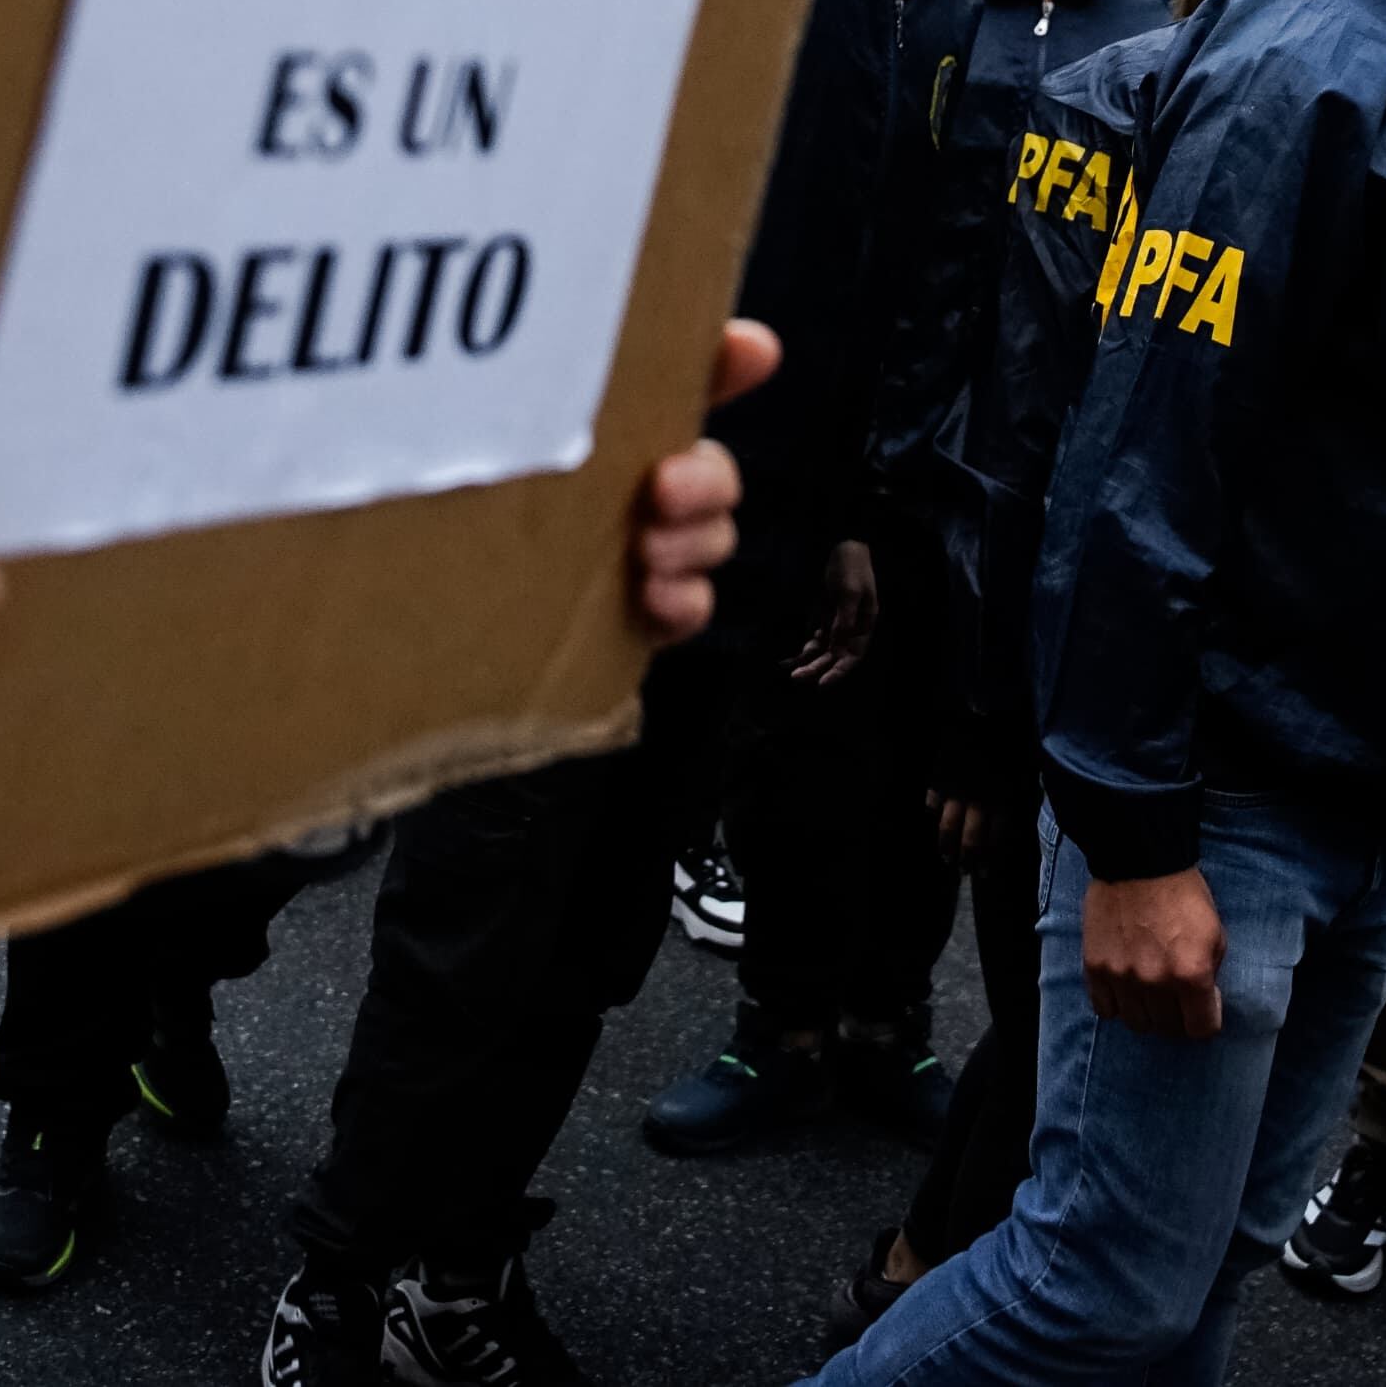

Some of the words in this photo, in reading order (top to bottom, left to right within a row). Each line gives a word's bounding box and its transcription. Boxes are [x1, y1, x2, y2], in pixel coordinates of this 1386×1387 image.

[253, 49, 375, 162] ES
[397, 53, 514, 159] UN
[1007, 131, 1113, 233] PFA
[115, 230, 534, 397] DELITO
[1118, 228, 1247, 348] PFA
